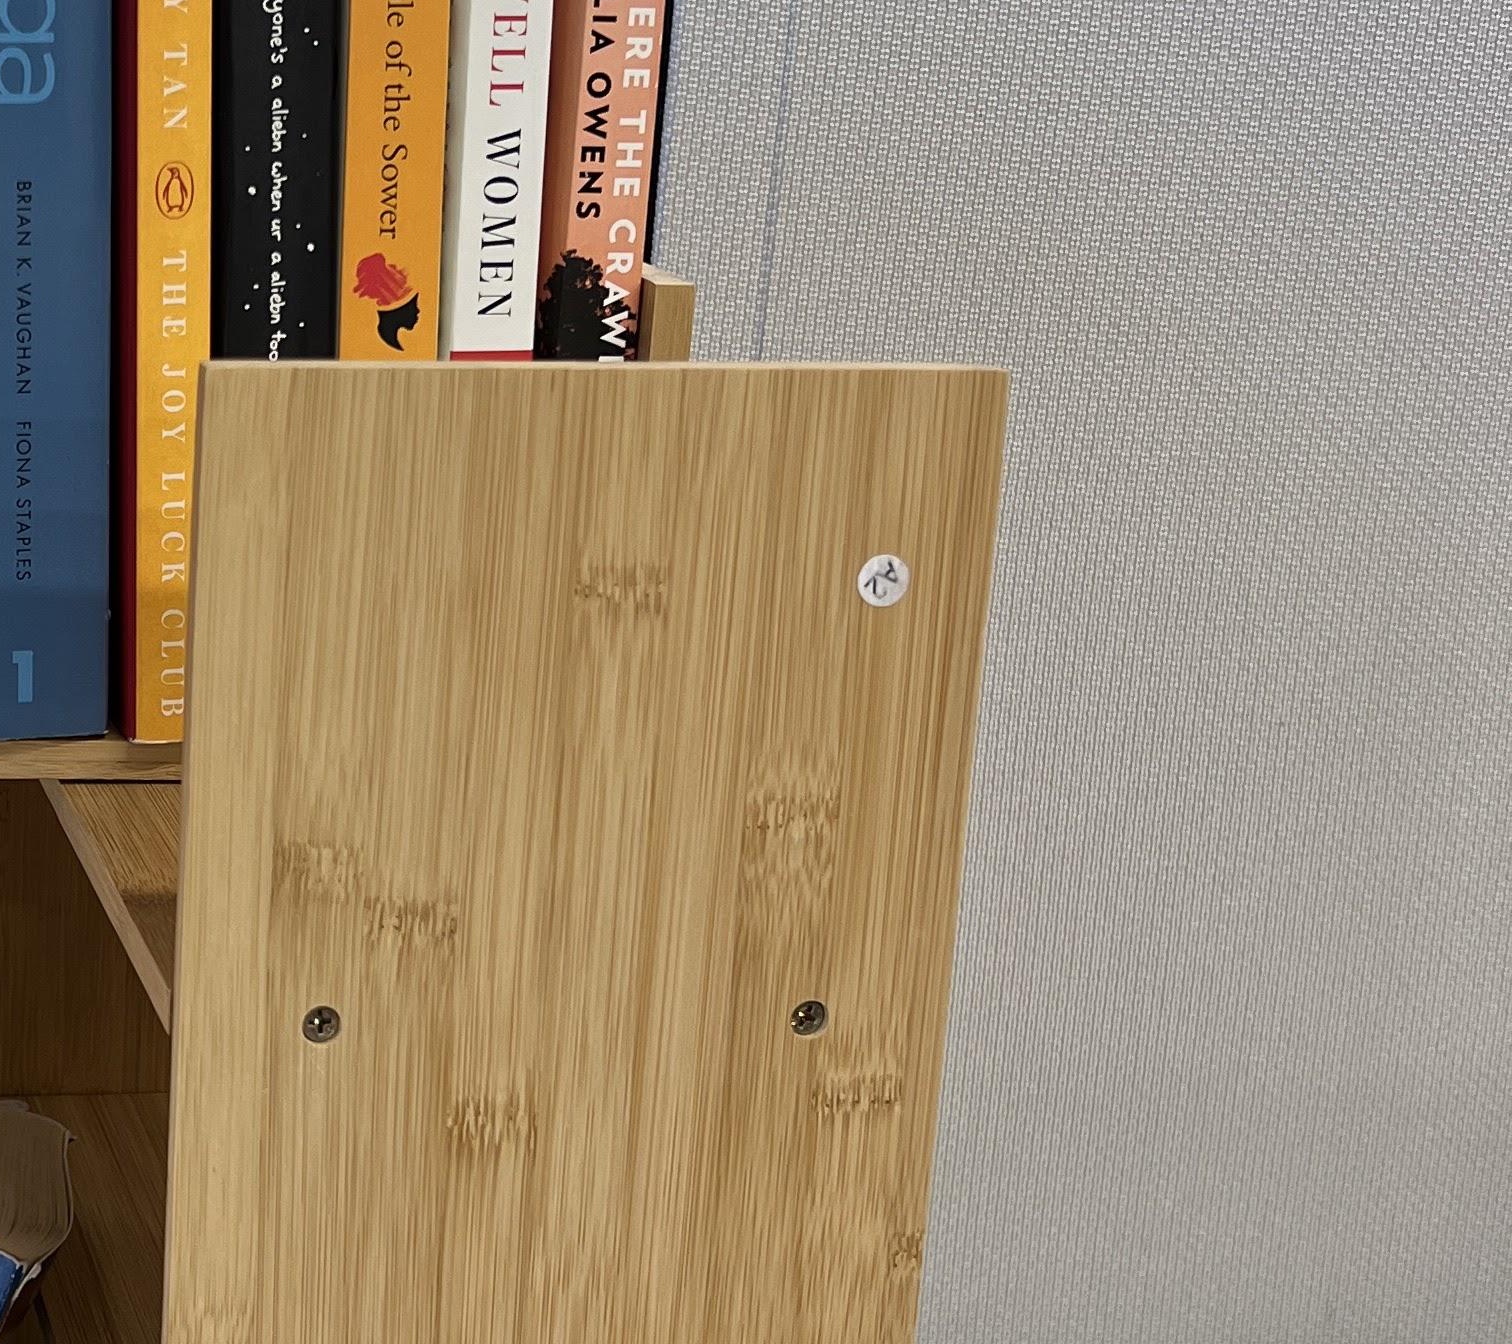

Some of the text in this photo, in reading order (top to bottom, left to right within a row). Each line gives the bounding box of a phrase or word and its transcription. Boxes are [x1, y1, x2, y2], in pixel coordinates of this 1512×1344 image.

[162, 43, 189, 130] TAN
[270, 74, 283, 90] a
[384, 38, 412, 78] of
[270, 97, 289, 154] aliebn
[382, 82, 412, 133] the
[575, 71, 613, 220] OWENS
[612, 109, 648, 199] THE
[270, 160, 288, 213] when
[378, 143, 409, 240] Sower
[270, 217, 283, 242] ur
[477, 128, 523, 318] WOMEN
[270, 251, 282, 266] a
[15, 179, 33, 396] BRIAN K. VAUGHAN
[269, 271, 287, 325] aliebn
[598, 218, 637, 361] CRAW
[268, 329, 287, 362] too
[15, 420, 33, 582] FIONA STAPLES
[159, 249, 188, 718] THE JOY LUCK CLUB
[11, 649, 35, 704] 1
